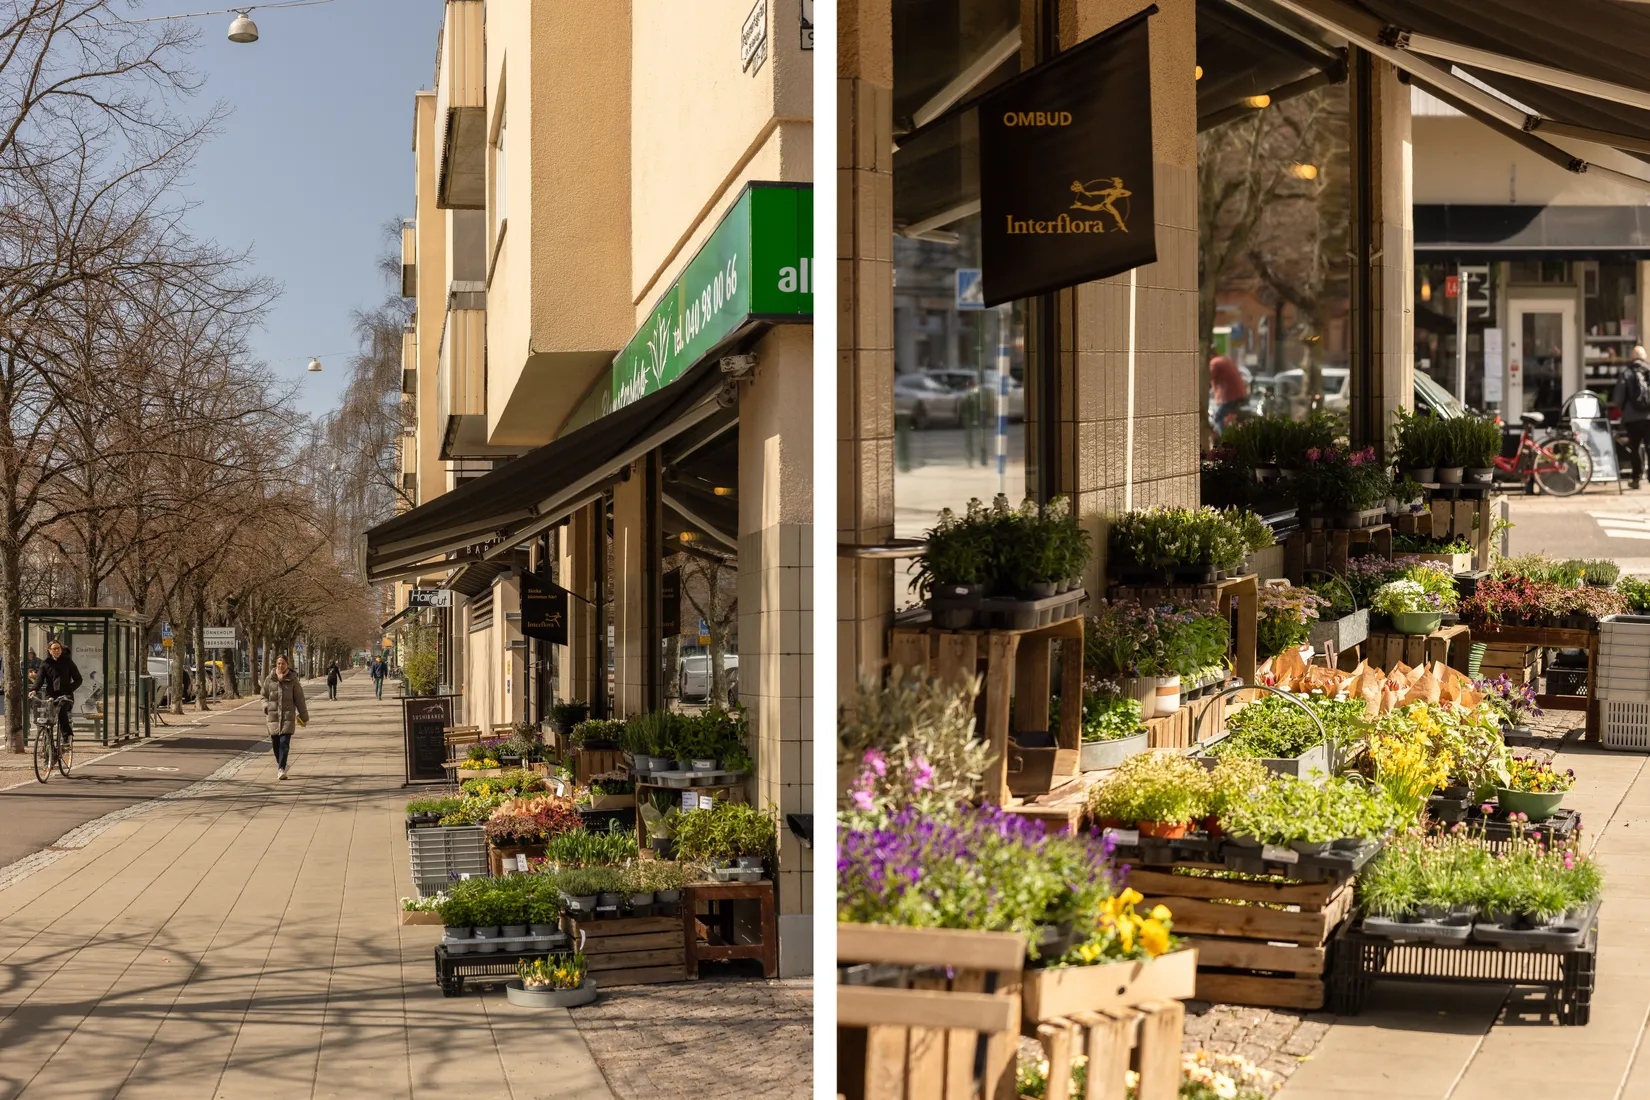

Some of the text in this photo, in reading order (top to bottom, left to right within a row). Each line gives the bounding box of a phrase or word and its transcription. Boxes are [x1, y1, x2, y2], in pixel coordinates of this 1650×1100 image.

[1003, 111, 1073, 127] OMBUD
[1006, 213, 1105, 234] Interflora
[685, 299, 699, 345] 040
[701, 284, 712, 329] 98
[713, 270, 724, 315] 00
[725, 253, 737, 301] 66
[411, 590, 433, 602] Hair
[412, 713, 445, 721] SUSHIBAREN
